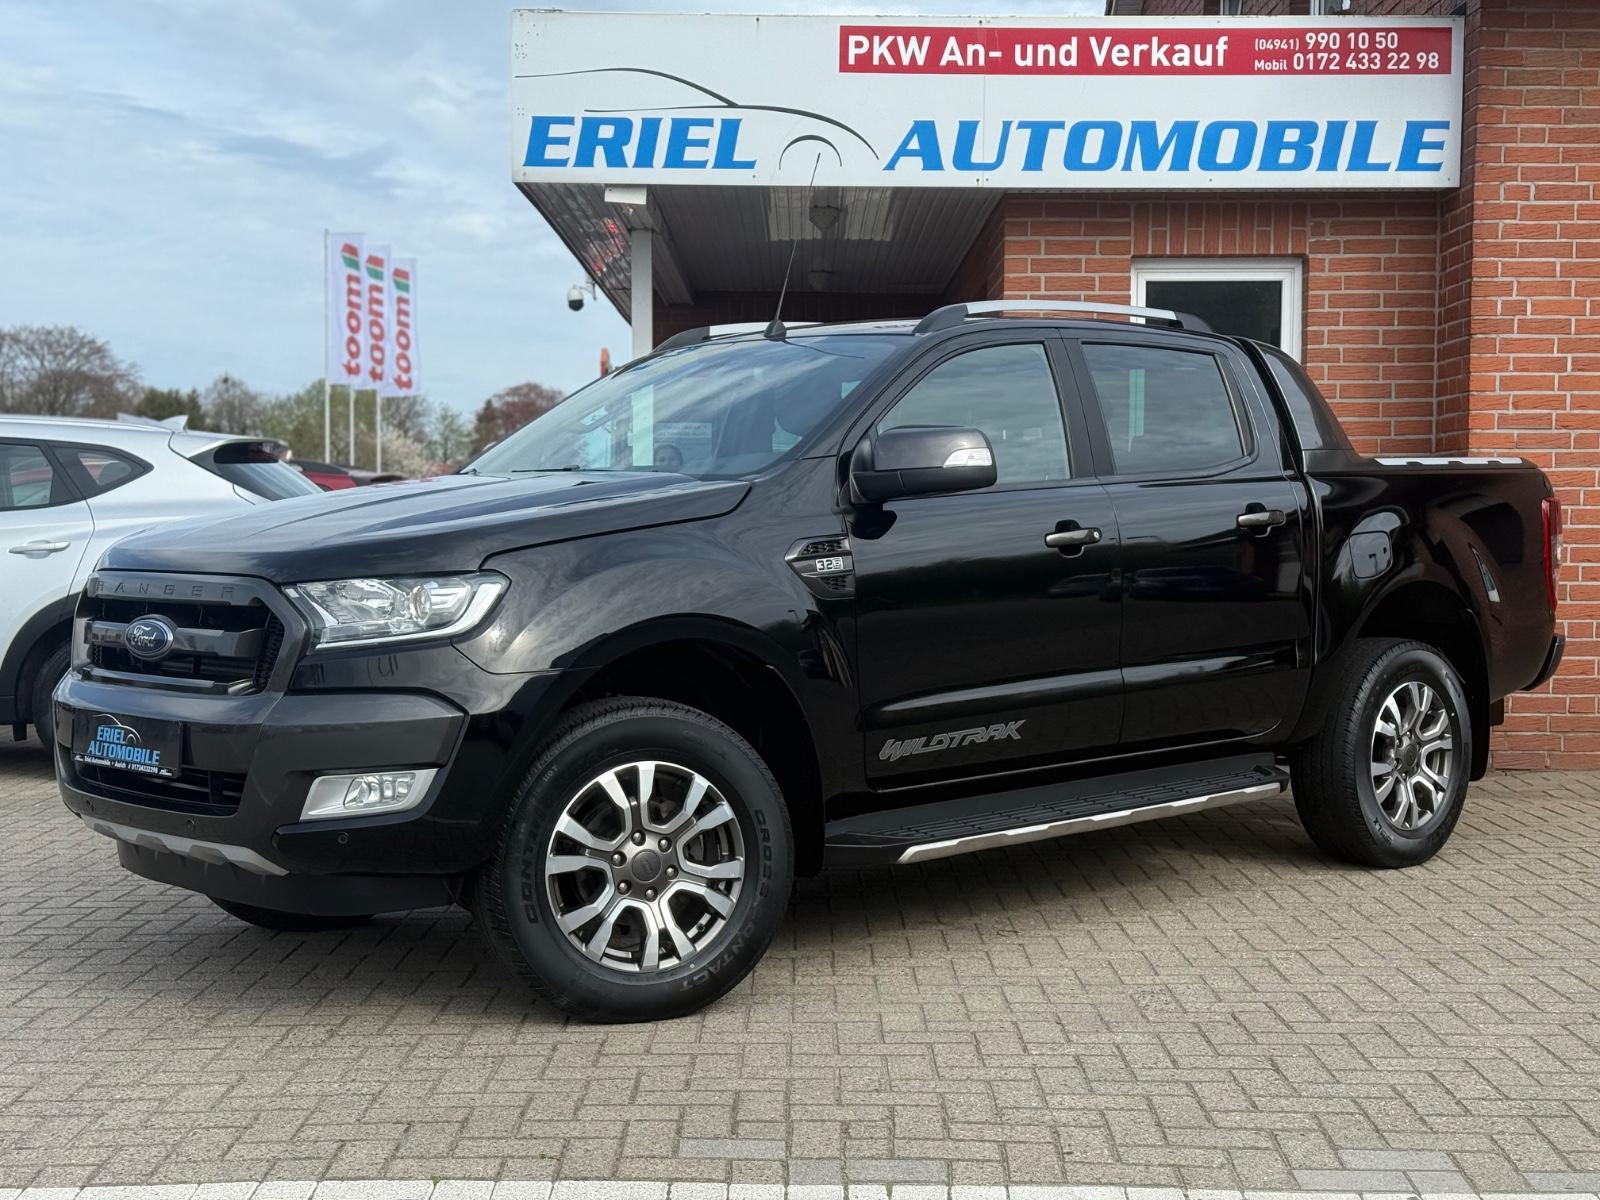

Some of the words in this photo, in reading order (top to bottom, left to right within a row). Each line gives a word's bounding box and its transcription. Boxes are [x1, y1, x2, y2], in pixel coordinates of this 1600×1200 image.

[847, 35, 931, 66] PKW
[939, 36, 1002, 67] An-
[1014, 37, 1078, 67] und
[1090, 35, 1229, 68] Verkauf
[1254, 38, 1300, 51] (04941)
[1305, 32, 1340, 50] 990
[1347, 32, 1369, 49] 10
[1375, 32, 1399, 49] 50
[1254, 59, 1288, 71] Mobil
[1293, 52, 1340, 70] 0172
[1345, 52, 1381, 70] 433
[1387, 52, 1410, 70] 22
[1416, 51, 1440, 69] 98
[522, 115, 757, 170] ERIEL
[882, 119, 1451, 172] AUTOMOBILE
[342, 273, 361, 376] toom
[368, 284, 384, 382] toom
[393, 295, 413, 390] toom
[96, 580, 235, 599] RANGER
[132, 625, 156, 646] Ford
[97, 727, 126, 744] ERIEL
[878, 719, 1027, 762] WILDTRAK
[87, 741, 160, 765] AUTOMOBILE
